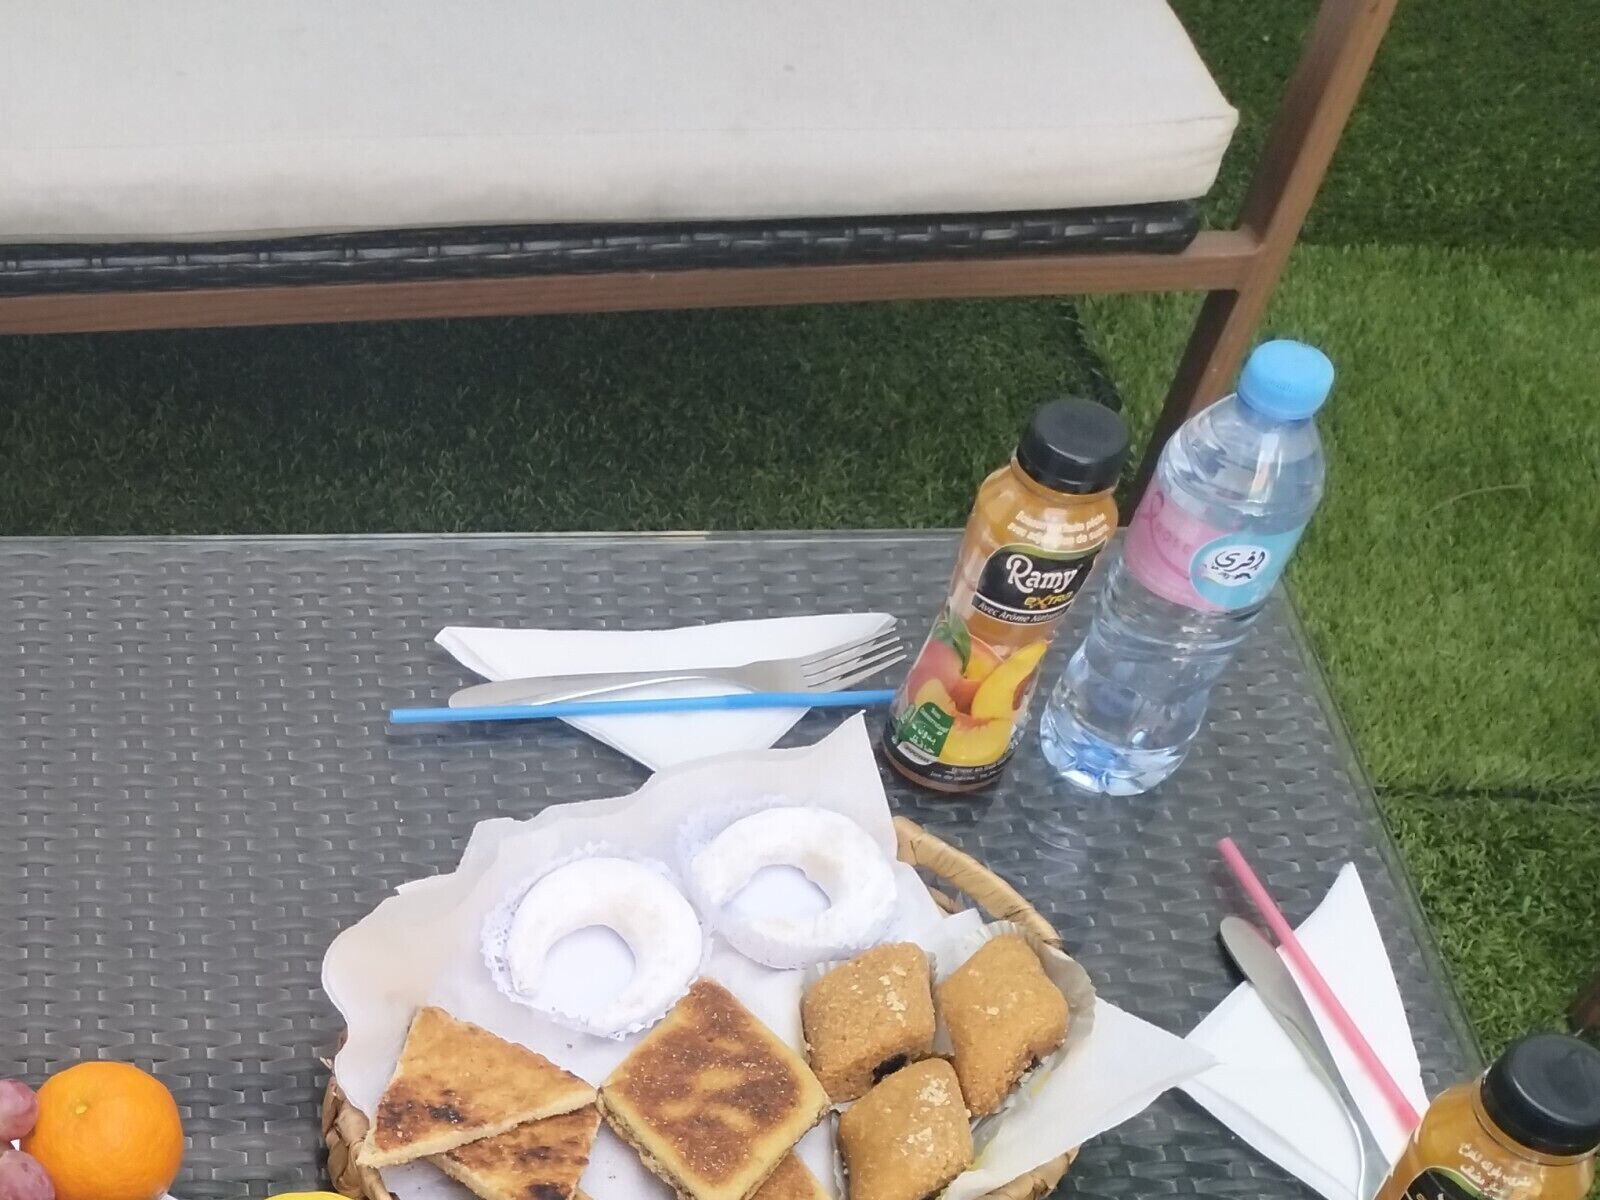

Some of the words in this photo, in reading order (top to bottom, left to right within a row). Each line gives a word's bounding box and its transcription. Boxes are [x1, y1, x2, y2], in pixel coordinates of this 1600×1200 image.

[1005, 554, 1079, 594] Ramy
[978, 602, 999, 617] Avec
[999, 611, 1031, 624] Arôme
